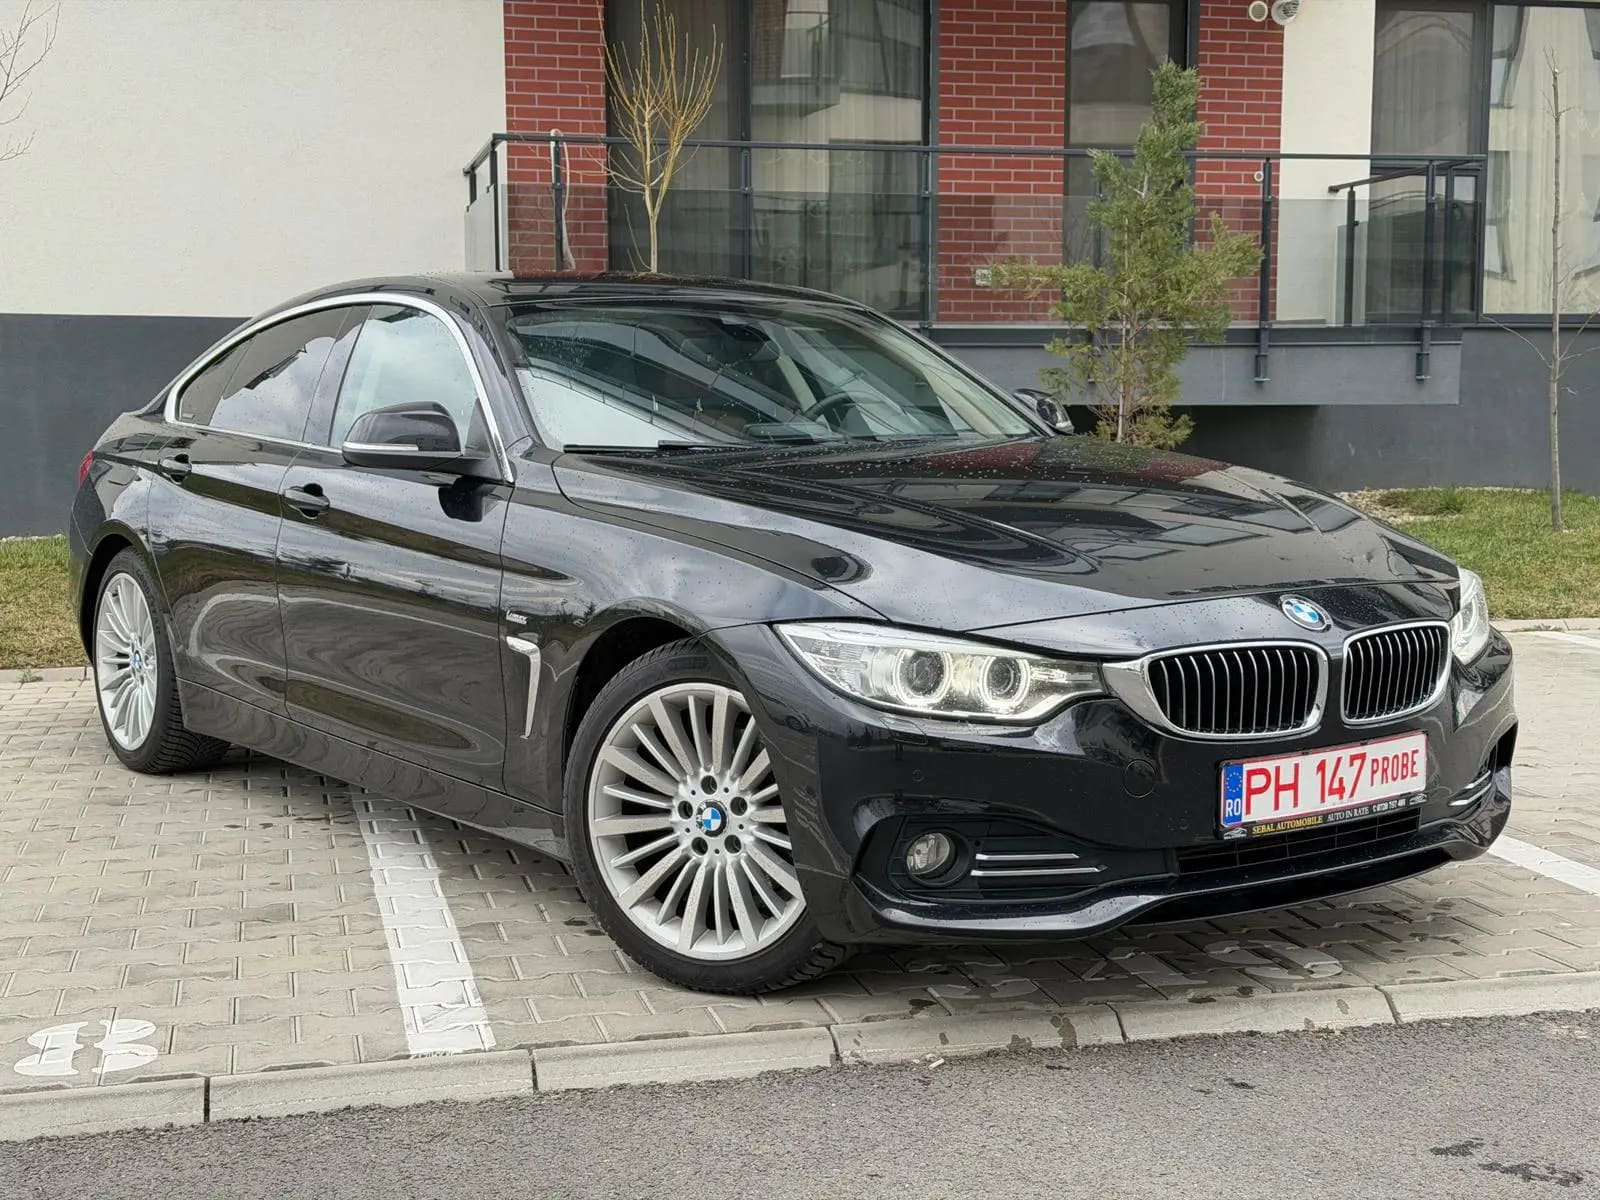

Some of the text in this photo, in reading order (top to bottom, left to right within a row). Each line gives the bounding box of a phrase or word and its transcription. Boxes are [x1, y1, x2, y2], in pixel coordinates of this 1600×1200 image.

[1245, 749, 1420, 816] PH 147 PROBE
[1225, 798, 1241, 818] RO
[1252, 823, 1276, 835] SEBAL
[1276, 815, 1324, 831] AUTOMOBILE
[1326, 812, 1345, 822] AUTO
[1345, 810, 1353, 819] IN
[1353, 806, 1370, 817] RATE
